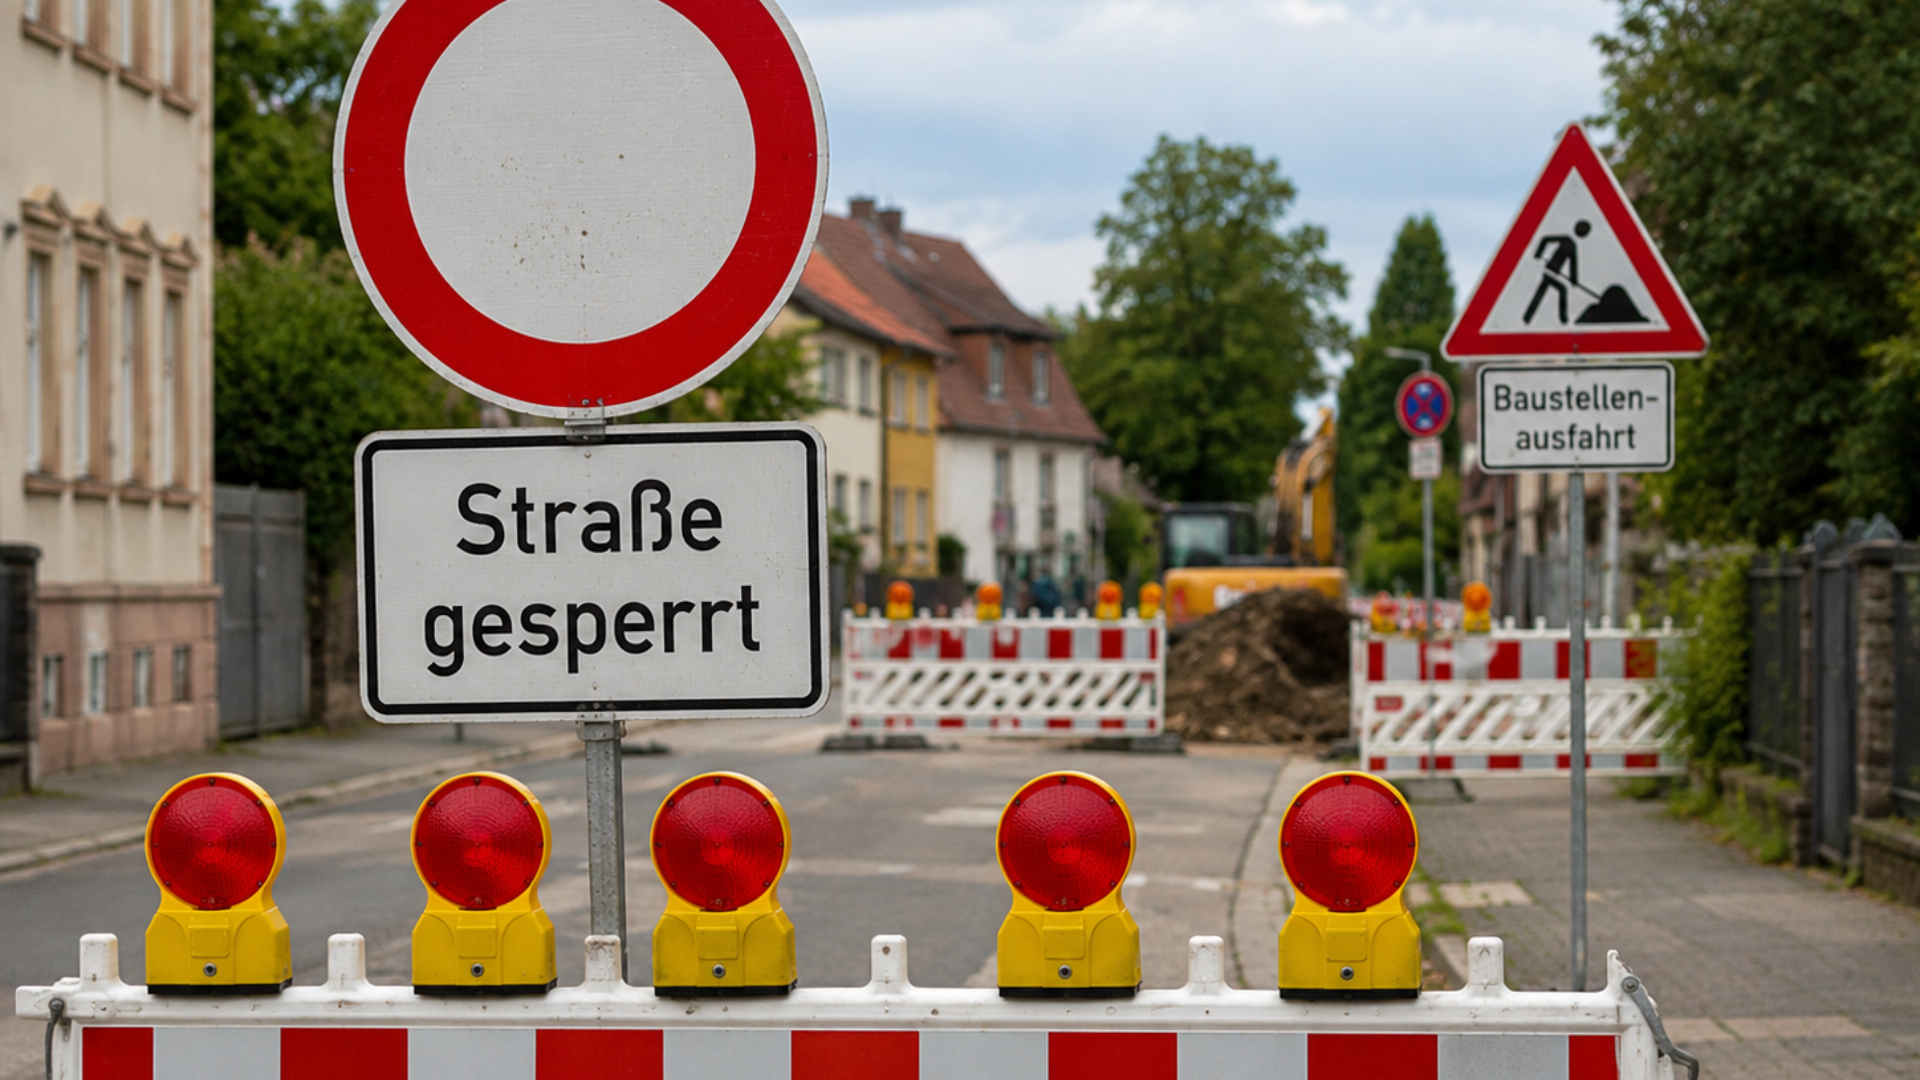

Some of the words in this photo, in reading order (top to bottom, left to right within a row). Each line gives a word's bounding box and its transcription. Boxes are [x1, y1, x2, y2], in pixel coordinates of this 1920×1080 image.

[1494, 384, 1659, 411] Baustellen-
[1516, 424, 1636, 450] ausfahrt
[456, 478, 723, 556] Straße
[424, 585, 761, 677] gesperrt
